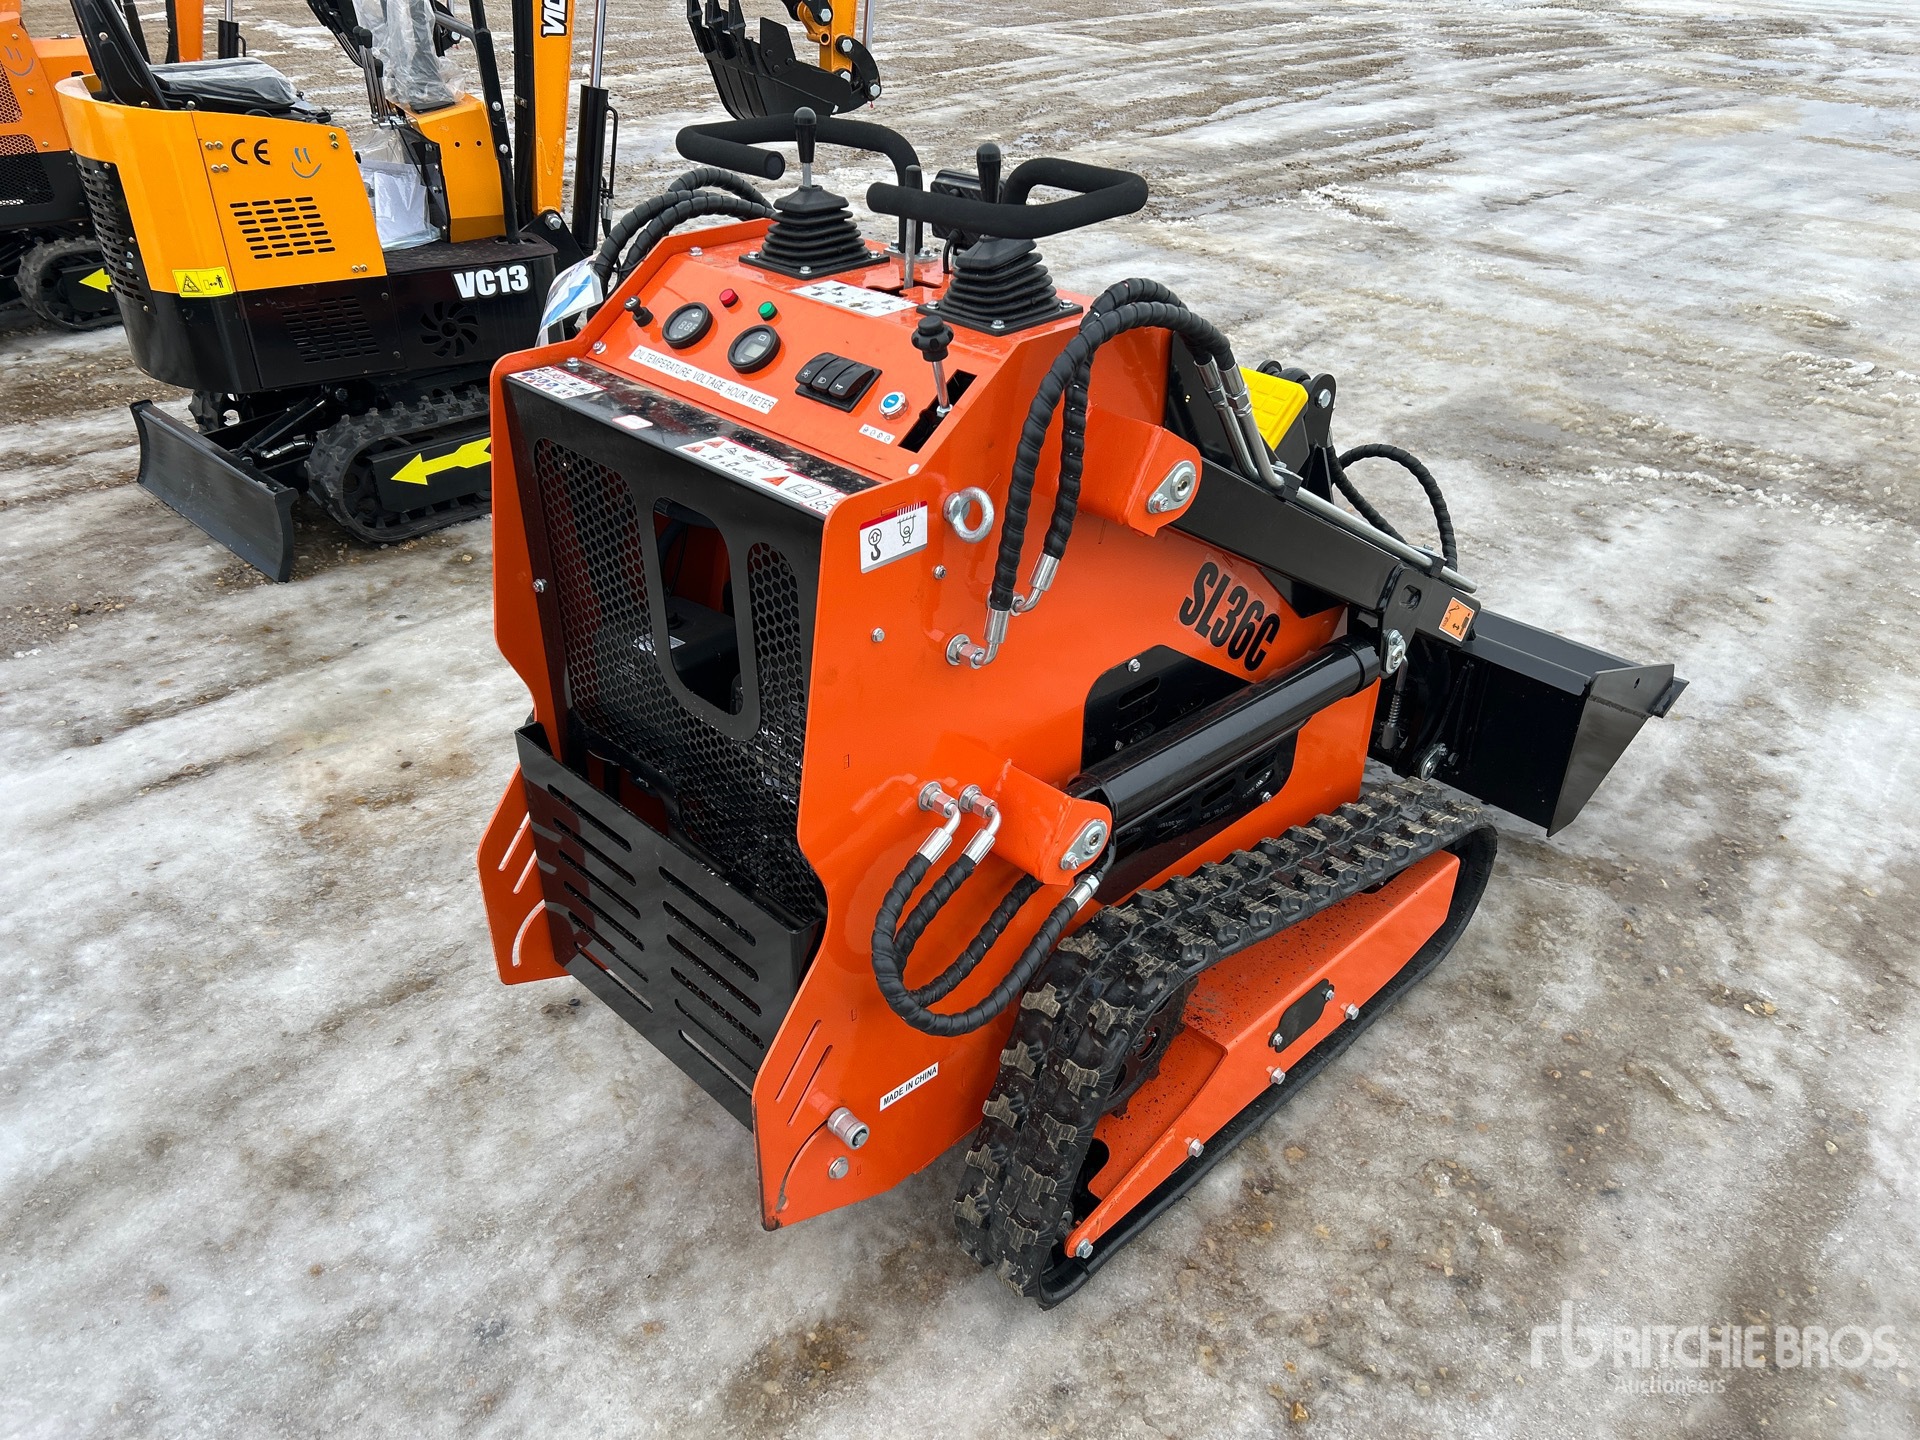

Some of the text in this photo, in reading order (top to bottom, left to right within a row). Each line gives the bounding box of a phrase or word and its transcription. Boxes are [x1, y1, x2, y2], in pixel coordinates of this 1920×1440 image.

[230, 138, 271, 165] CE
[453, 264, 529, 299] VC13
[643, 351, 693, 379] TEMPERATURE
[692, 371, 726, 391] VOLTAGE
[725, 385, 750, 401] HOUR
[746, 393, 775, 410] METER
[1179, 561, 1281, 672] SL36C
[883, 1066, 937, 1106] MADE IN CHINA
